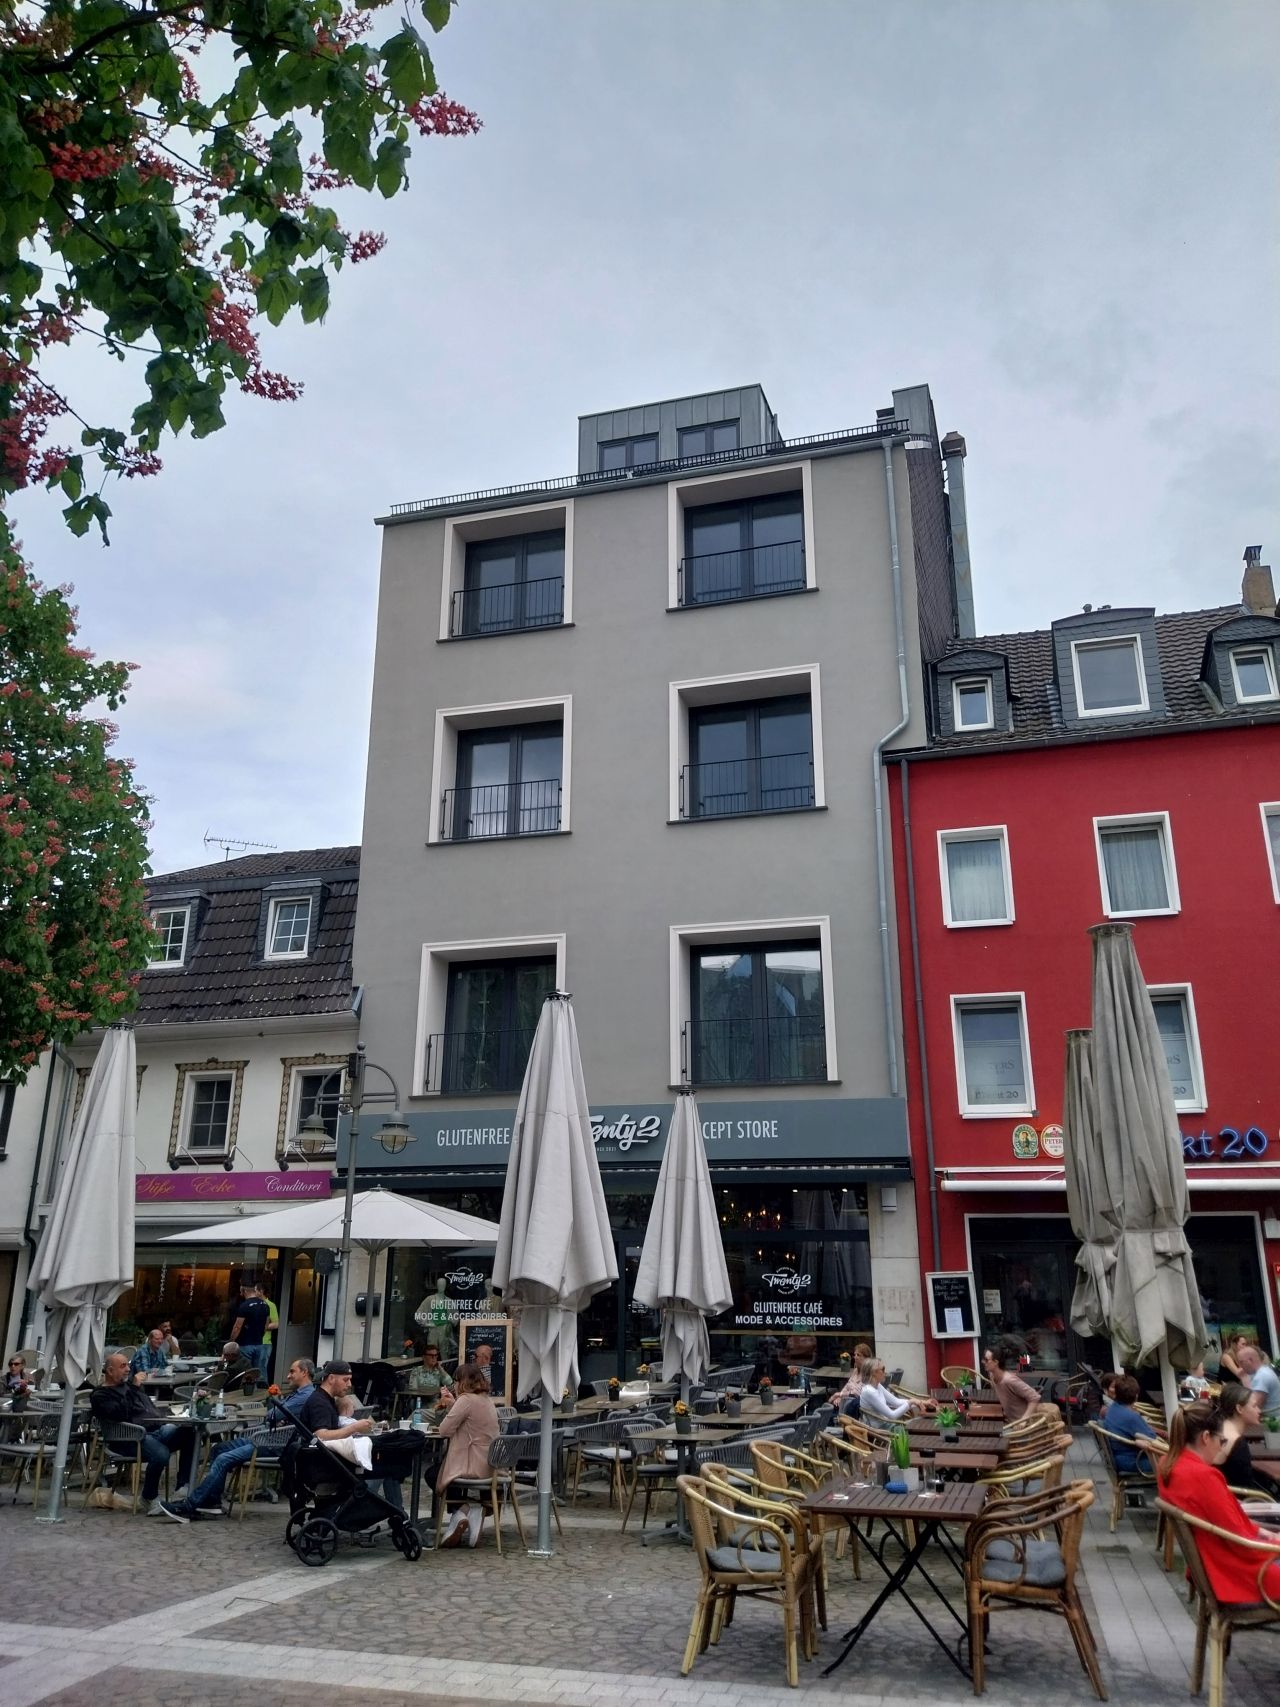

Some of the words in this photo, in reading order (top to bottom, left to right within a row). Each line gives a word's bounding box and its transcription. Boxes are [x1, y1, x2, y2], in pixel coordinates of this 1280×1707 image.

[1006, 1090, 1019, 1099] 20
[437, 1127, 510, 1147] GLUTENFREE
[589, 1113, 661, 1151] enty2
[702, 1121, 733, 1140] CEPT
[737, 1120, 779, 1139] STORE
[1181, 1130, 1215, 1159] kt
[1216, 1124, 1268, 1158] 20
[191, 1176, 236, 1194] Ecke
[265, 1175, 323, 1194] Conditorei
[430, 1299, 473, 1311] GLUTENFREE
[753, 1301, 802, 1315] GLUTENFREE
[803, 1300, 823, 1315] CAFÉ
[414, 1312, 439, 1321] MODE
[440, 1312, 447, 1321] &
[448, 1312, 508, 1321] ACCESSOIRES
[735, 1315, 764, 1325] MODE
[765, 1316, 773, 1325] &
[774, 1316, 844, 1327] ACCESSOIRES
